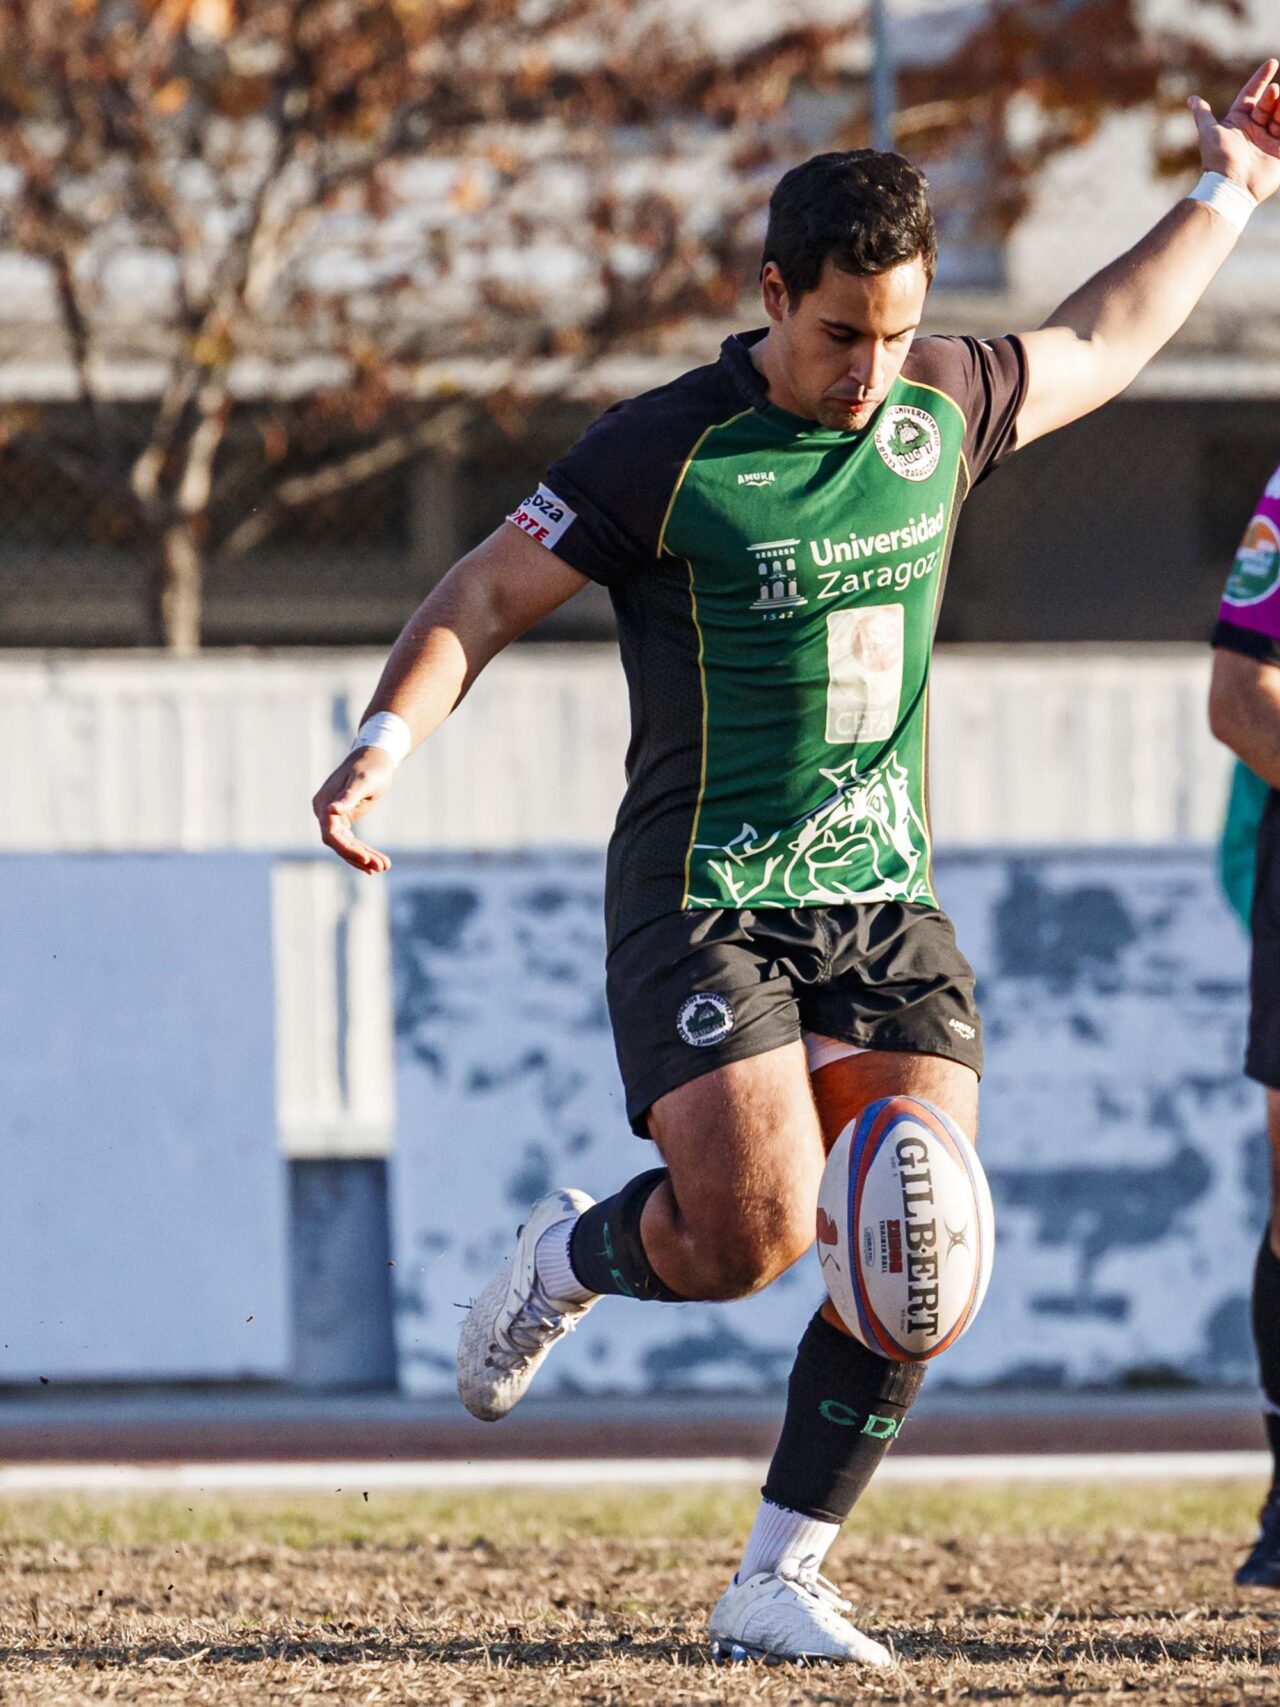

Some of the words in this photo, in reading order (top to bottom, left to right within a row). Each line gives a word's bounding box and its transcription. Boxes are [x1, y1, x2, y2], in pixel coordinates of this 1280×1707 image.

[737, 471, 776, 485] AMURA
[511, 508, 550, 542] RTE
[809, 502, 944, 567] Universidad
[816, 546, 940, 599] Zaragoz
[896, 1137, 939, 1337] GILBERT
[818, 1399, 906, 1439] CD
